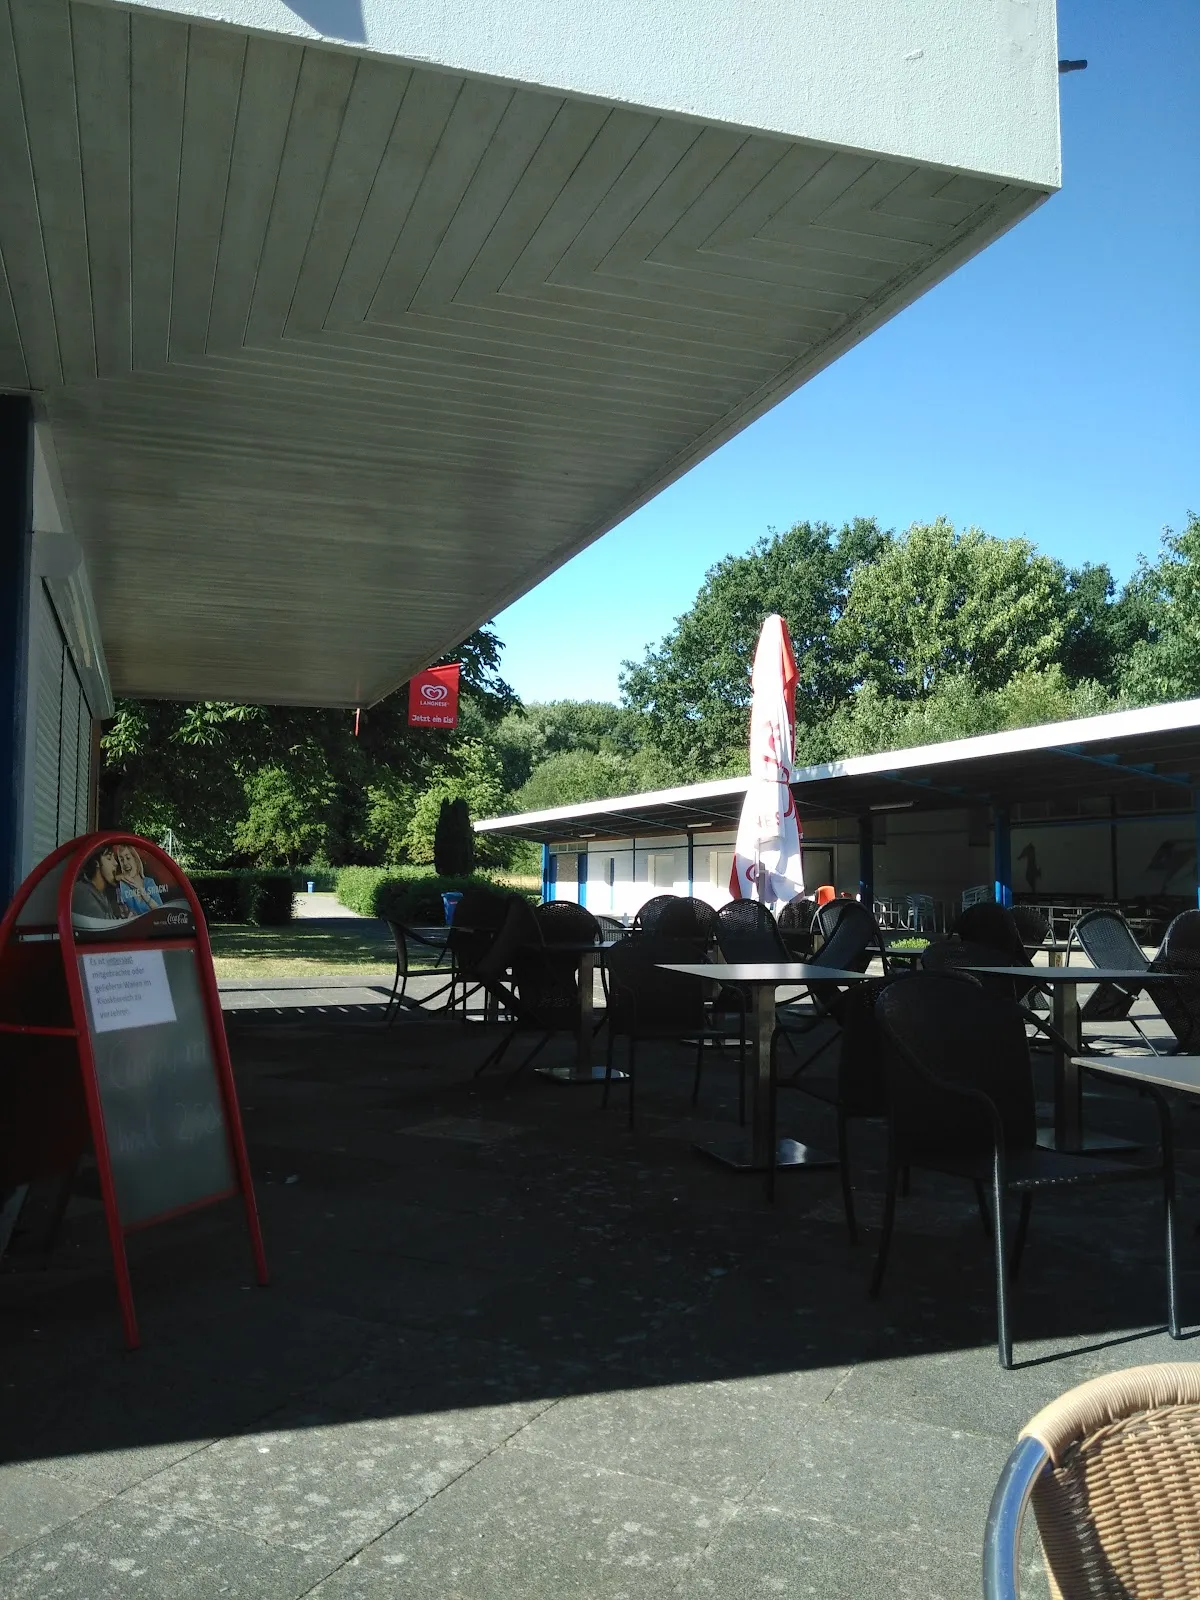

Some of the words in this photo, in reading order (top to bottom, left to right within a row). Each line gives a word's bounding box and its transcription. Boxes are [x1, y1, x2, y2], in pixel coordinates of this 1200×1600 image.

[411, 714, 431, 722] Jetzt
[432, 715, 442, 723] ein
[443, 716, 454, 724] Eis!
[124, 888, 140, 898] COKE
[167, 912, 188, 925] Coca-Cola
[90, 957, 97, 965] Es
[98, 957, 106, 965] ist
[92, 969, 130, 979] mitgebrachte
[131, 967, 144, 976] oder
[123, 980, 142, 989] Waren
[97, 995, 134, 1006] Kioskbereich
